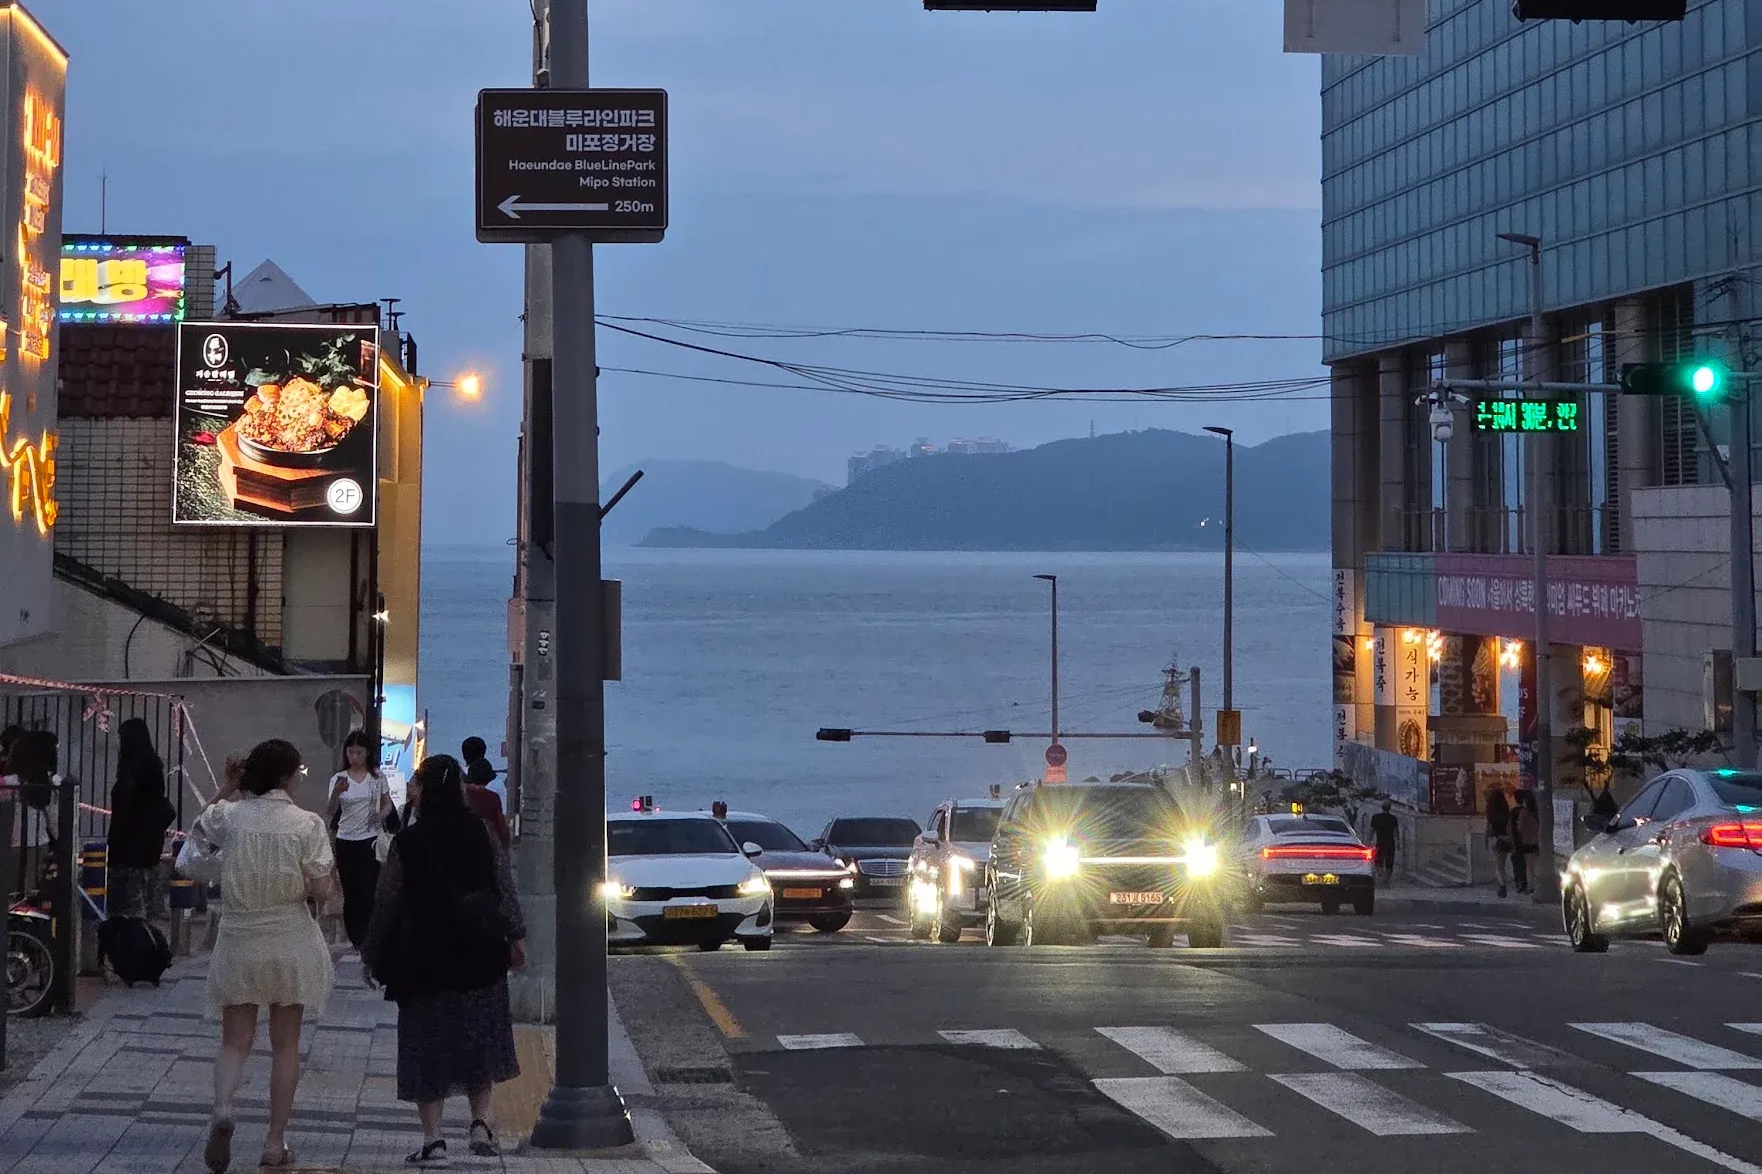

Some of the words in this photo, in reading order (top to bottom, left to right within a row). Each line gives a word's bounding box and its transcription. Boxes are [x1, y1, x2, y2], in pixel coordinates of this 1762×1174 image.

[493, 109, 656, 128] 해운대블루라인파크
[565, 134, 656, 152] 미포정거장
[508, 159, 572, 171] Haeundae
[574, 159, 656, 171] BlueLinePark
[579, 176, 609, 189] Mipo
[611, 176, 656, 187] Station
[614, 200, 654, 213] 250m
[335, 488, 356, 503] 2F
[1335, 570, 1346, 633] 전복수육
[1438, 575, 1465, 607] COMING
[1466, 577, 1486, 609] SOON
[1487, 577, 1513, 612] 서울에서
[1375, 637, 1387, 693] 전복죽
